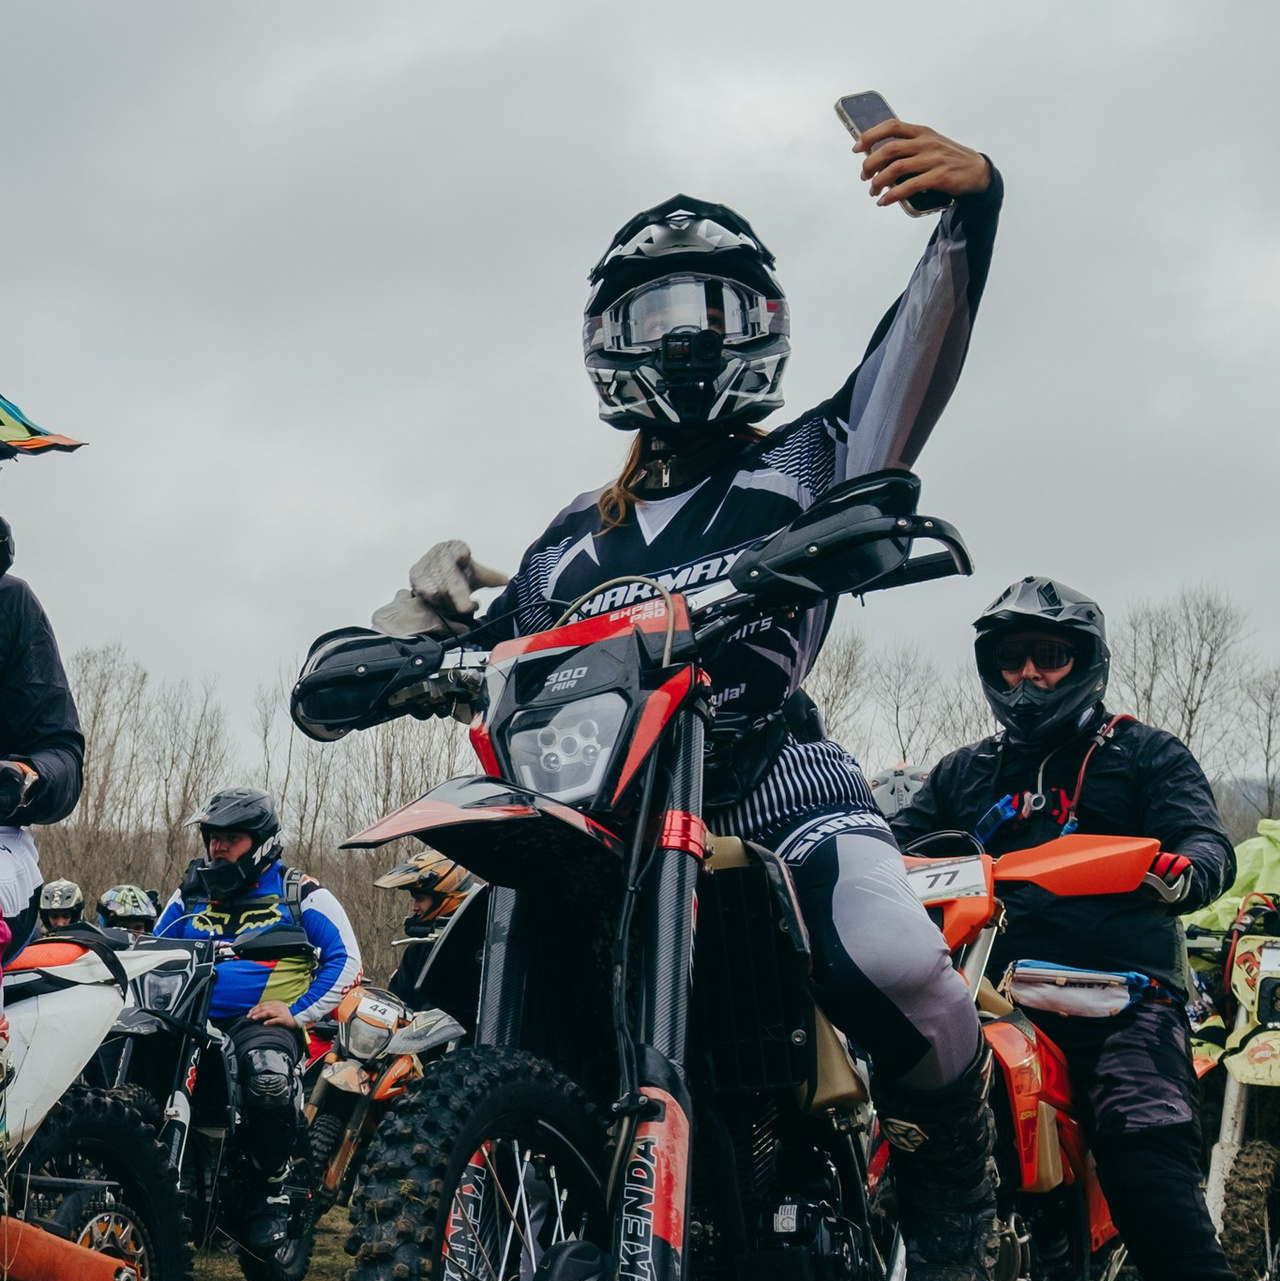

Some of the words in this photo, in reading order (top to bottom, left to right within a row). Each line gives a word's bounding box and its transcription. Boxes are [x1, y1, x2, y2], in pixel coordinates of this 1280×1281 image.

[569, 549, 747, 624] HARMAX
[629, 607, 667, 624] PRO
[545, 667, 588, 688] 300
[552, 679, 577, 692] AIR
[925, 869, 960, 890] 77
[368, 1003, 389, 1017] 44
[620, 1135, 658, 1281] KENDA
